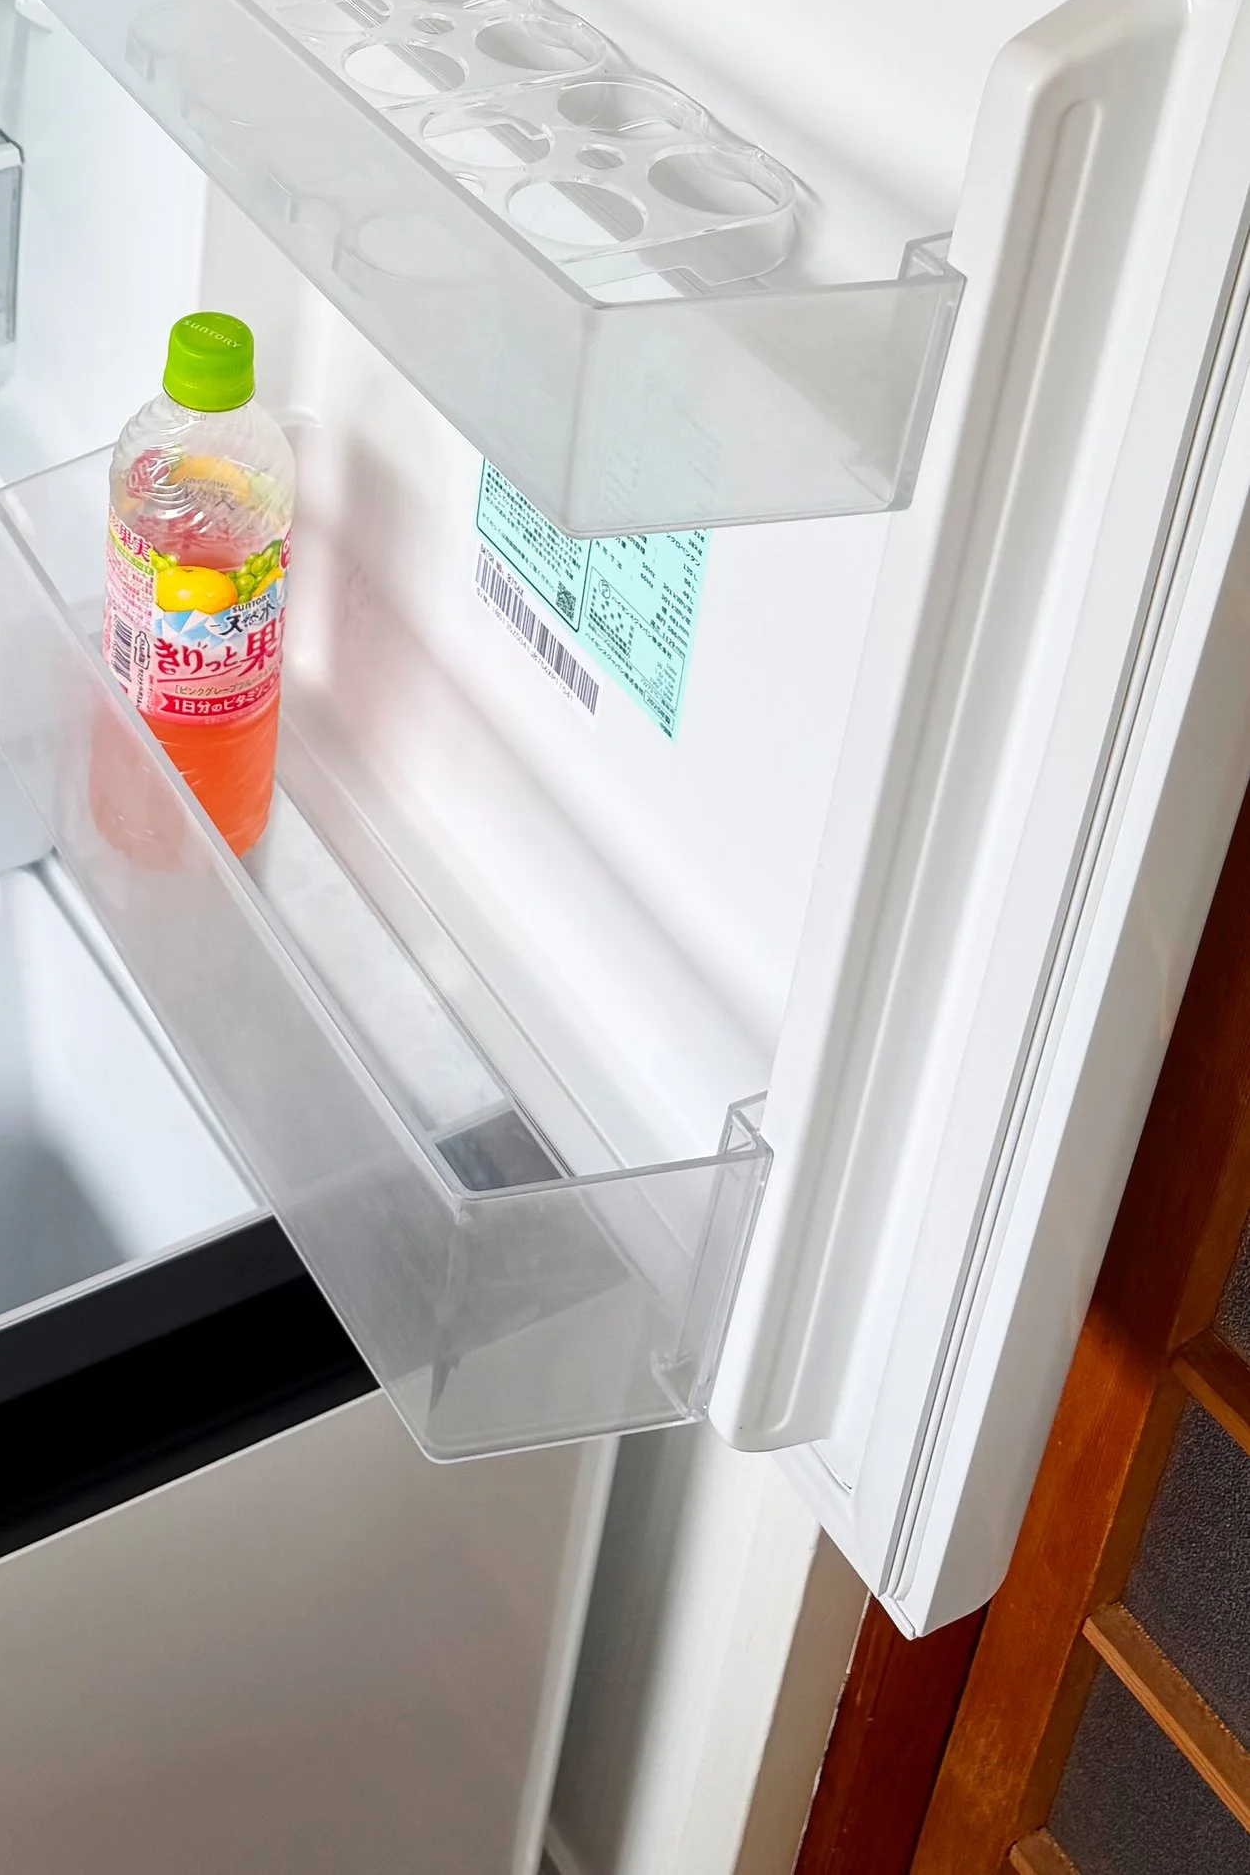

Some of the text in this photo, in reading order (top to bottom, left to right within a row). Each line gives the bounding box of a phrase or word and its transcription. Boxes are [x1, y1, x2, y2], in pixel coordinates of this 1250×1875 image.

[181, 319, 243, 349] SUNTORY
[213, 600, 276, 636] 天然水
[231, 592, 271, 614] SUNTORY
[153, 609, 286, 678] きりっと果
